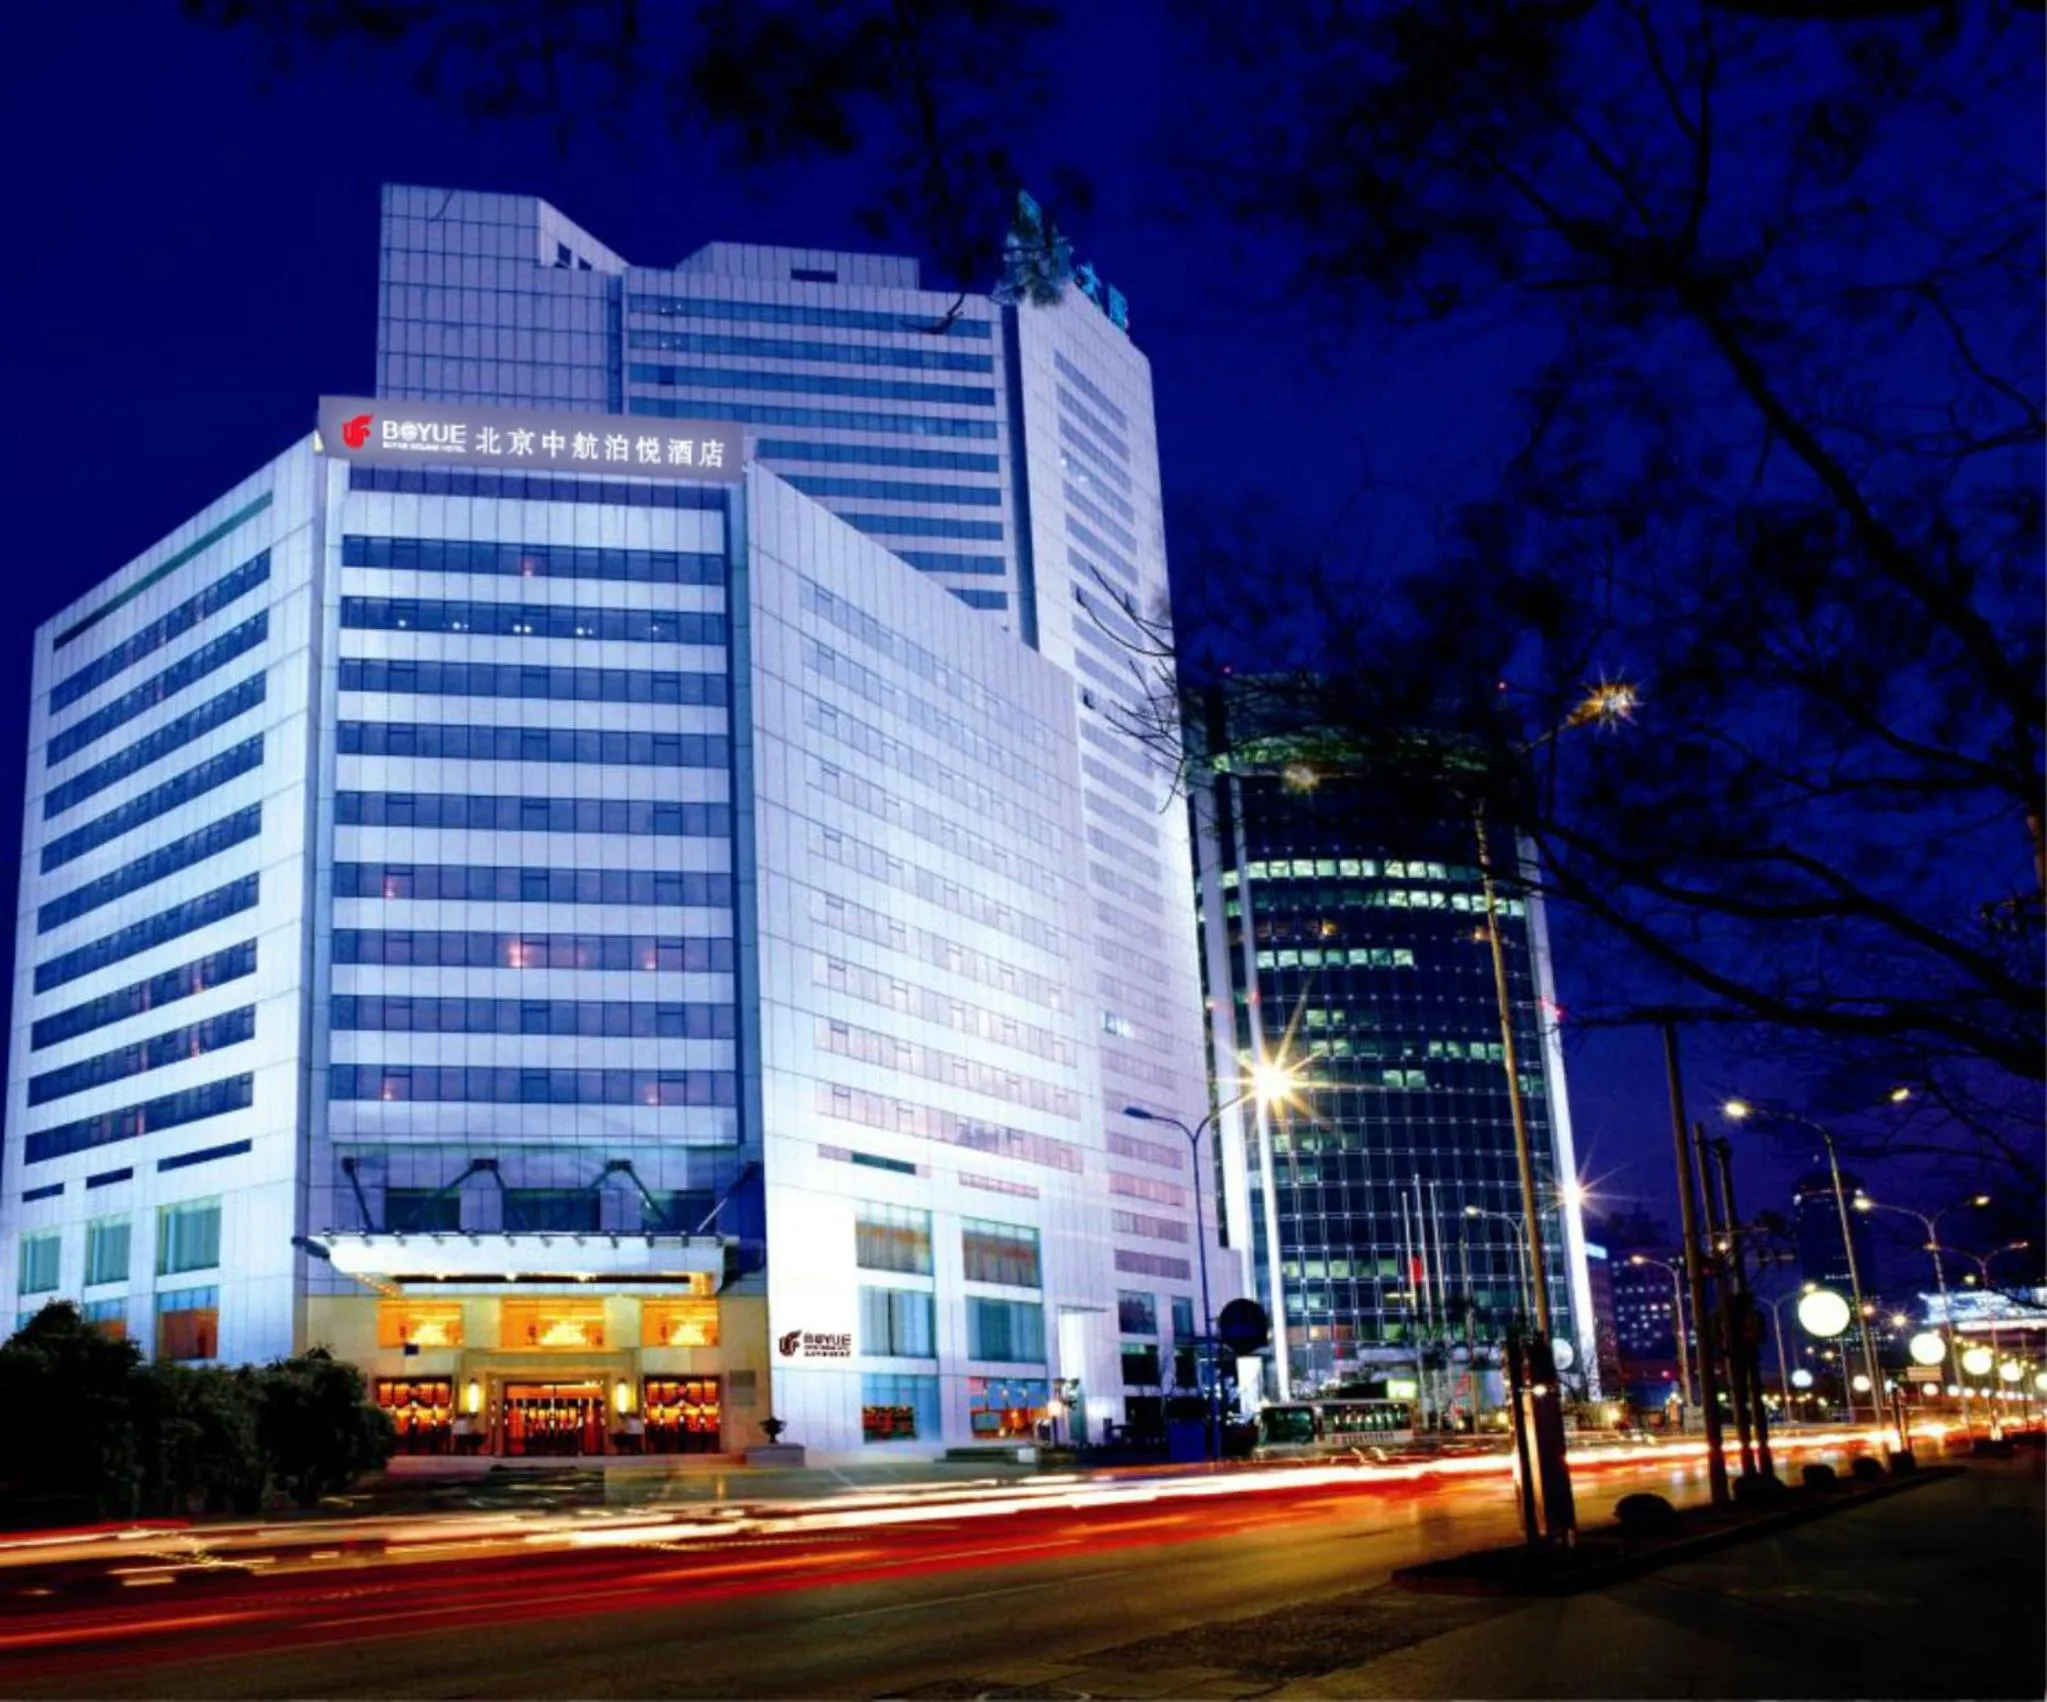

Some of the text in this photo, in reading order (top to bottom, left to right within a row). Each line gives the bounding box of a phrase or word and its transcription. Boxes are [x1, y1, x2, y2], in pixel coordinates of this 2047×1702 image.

[382, 420, 467, 443] BOYUE
[476, 427, 725, 468] 北京中航泊悦酒店
